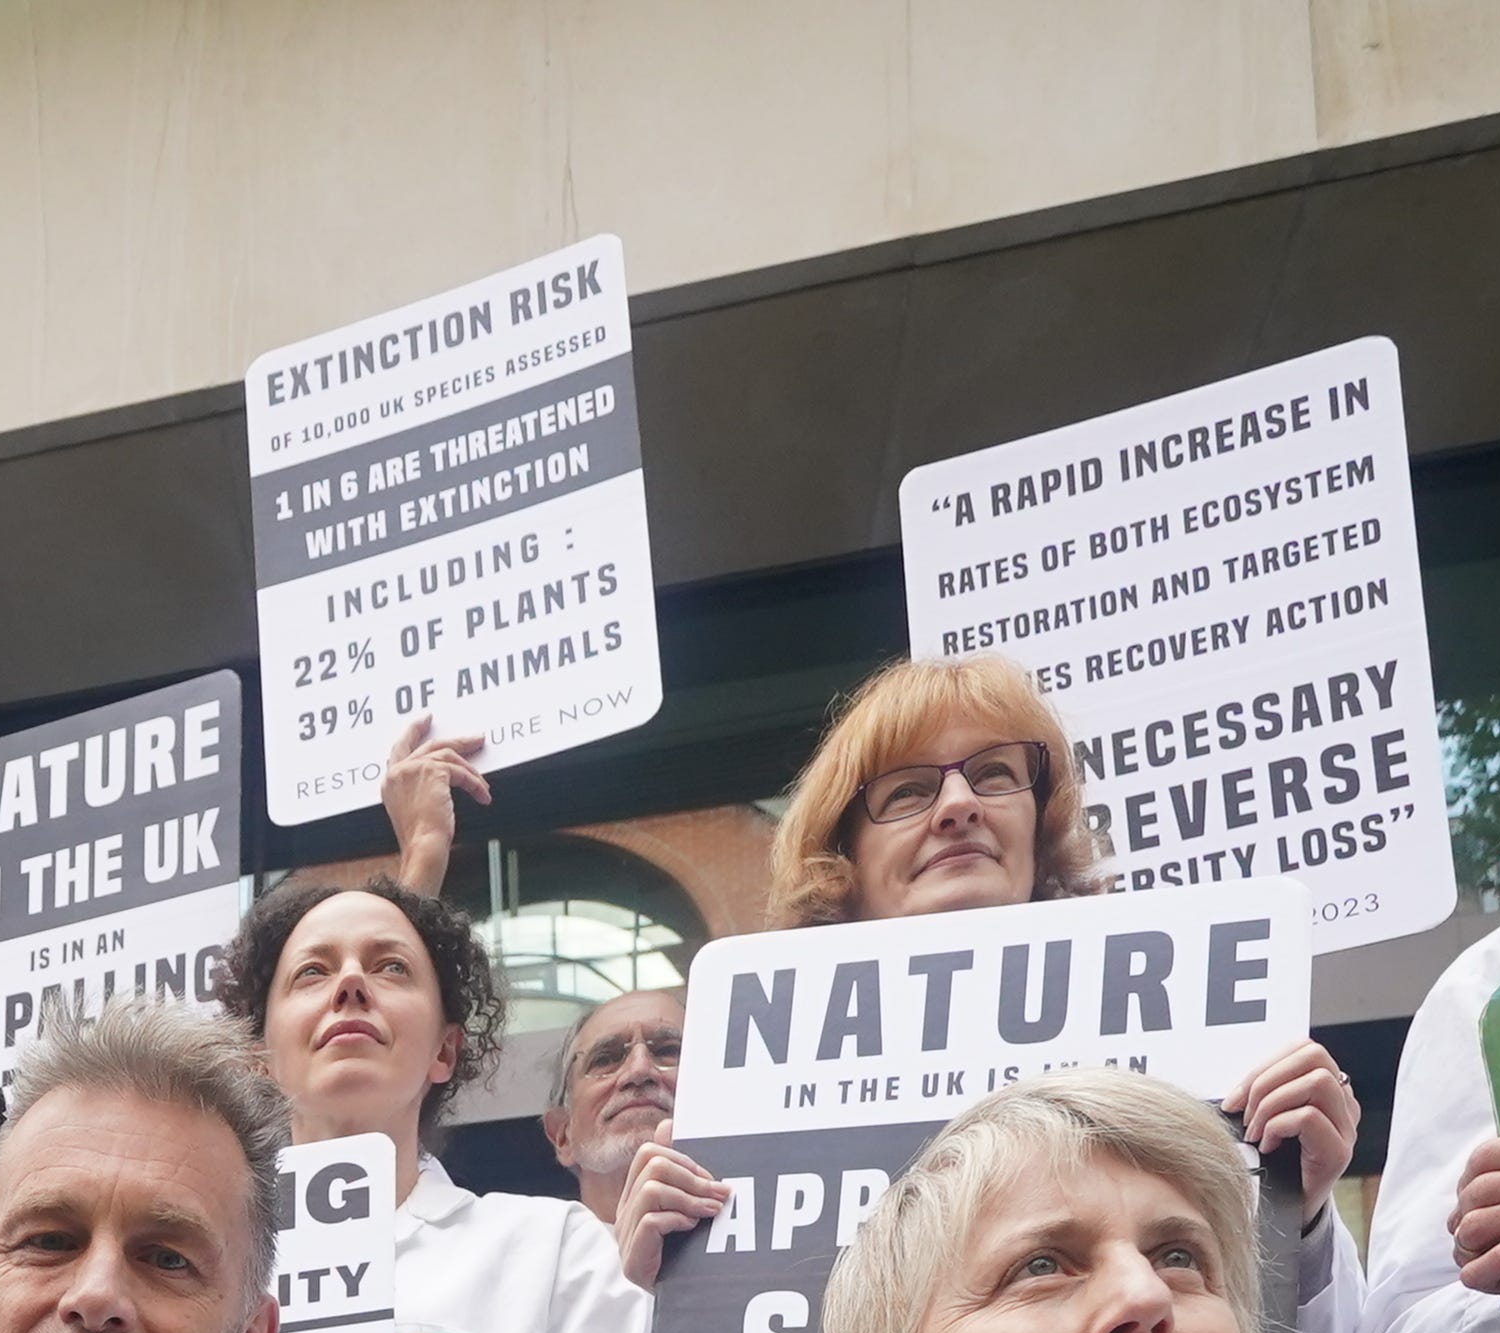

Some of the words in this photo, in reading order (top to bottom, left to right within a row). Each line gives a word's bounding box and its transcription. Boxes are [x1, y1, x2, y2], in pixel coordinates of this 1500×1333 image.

[267, 301, 493, 406] EXTINCTION
[510, 260, 603, 325] RISK
[270, 434, 293, 452] OF
[302, 409, 371, 441] 10,000
[380, 396, 405, 415] UK
[414, 366, 496, 407] SPECIES
[505, 326, 608, 377] ASSESSED
[303, 480, 332, 512] IN
[340, 471, 358, 501] 6
[368, 451, 422, 492] ARE
[431, 385, 615, 473] THREATENED
[306, 512, 388, 559] WITH
[400, 444, 591, 530] EXTINCTION
[991, 457, 1102, 516] RAPID
[1119, 396, 1311, 482] INCREASE
[1329, 378, 1369, 420] IN
[326, 533, 541, 622] INCLUDING
[938, 553, 1029, 599] RATES
[1041, 541, 1077, 572] OF
[1090, 515, 1169, 559] BOTH
[1183, 455, 1376, 534] ECOSYSTEM
[942, 584, 1139, 655] RESTORATION
[1152, 566, 1210, 604] AND
[1223, 518, 1381, 584] TARGETED
[293, 638, 376, 689] 22%
[401, 618, 445, 659] OF
[467, 563, 618, 638] PLANTS
[298, 696, 374, 741] 39%
[396, 679, 437, 714] OF
[456, 621, 624, 698] ANIMALS
[20, 841, 124, 916] THE
[143, 812, 221, 882] UK
[29, 947, 55, 971] IS
[63, 938, 88, 964] IN
[95, 928, 125, 955] AN
[723, 918, 1272, 1070] NATURE
[783, 1084, 816, 1109] IN
[837, 1076, 899, 1104] THE
[921, 1070, 966, 1098] UK
